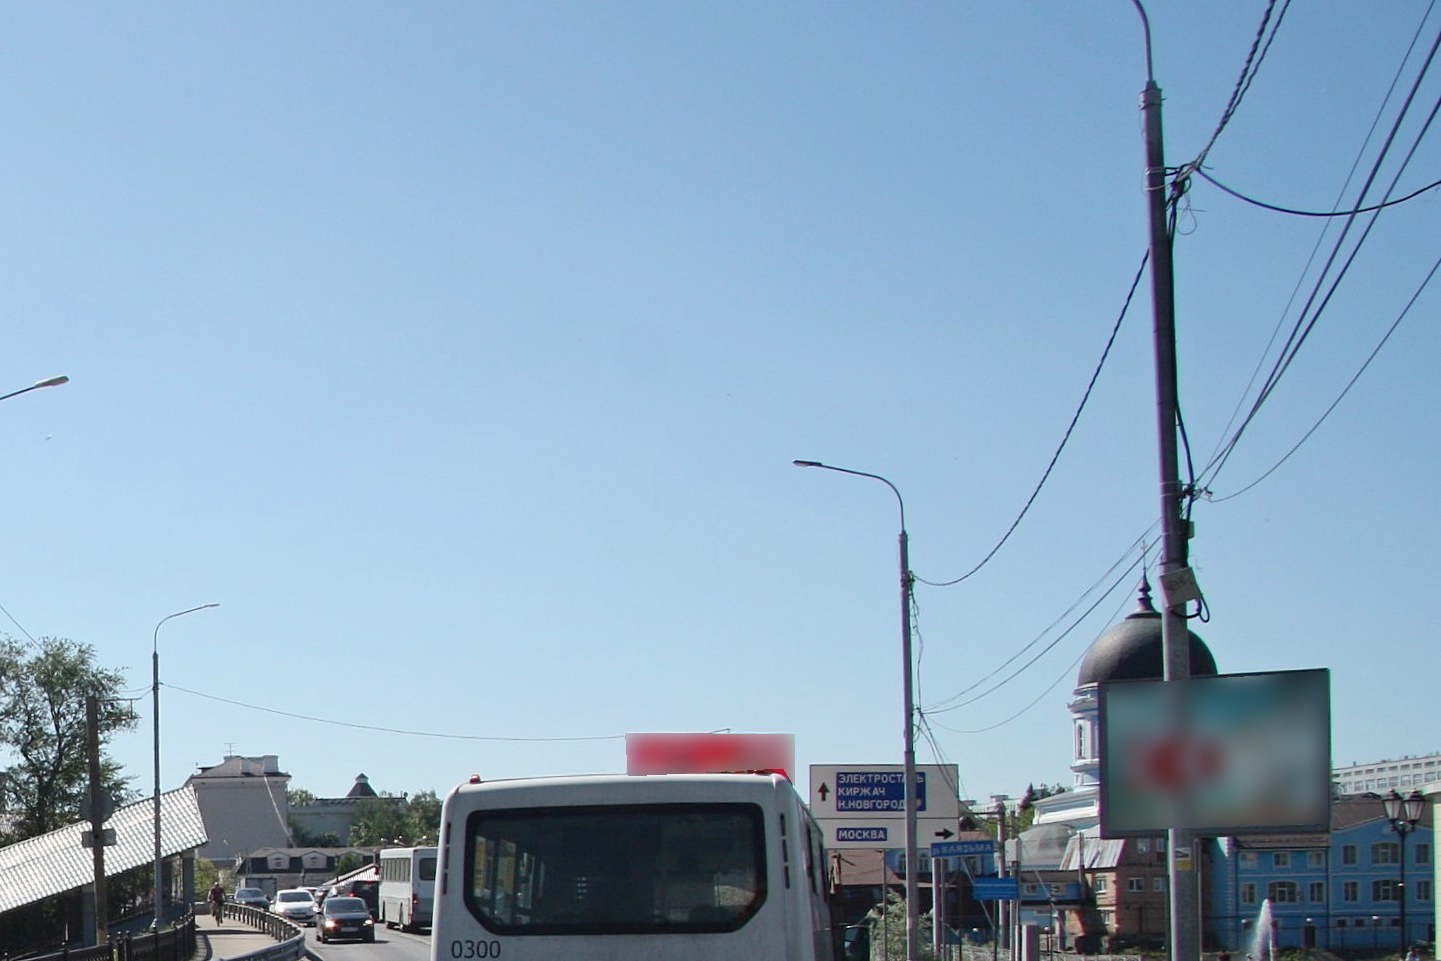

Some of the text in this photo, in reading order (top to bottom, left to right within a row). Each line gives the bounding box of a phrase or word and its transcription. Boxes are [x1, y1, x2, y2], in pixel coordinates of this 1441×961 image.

[838, 774, 924, 783] ЭЛЕКТРОСТЬ
[838, 787, 886, 796] КИРЖАЧ
[838, 799, 905, 810] Н.НОВГОРОД
[838, 831, 885, 840] МОСКВА
[451, 940, 501, 959] 0300
